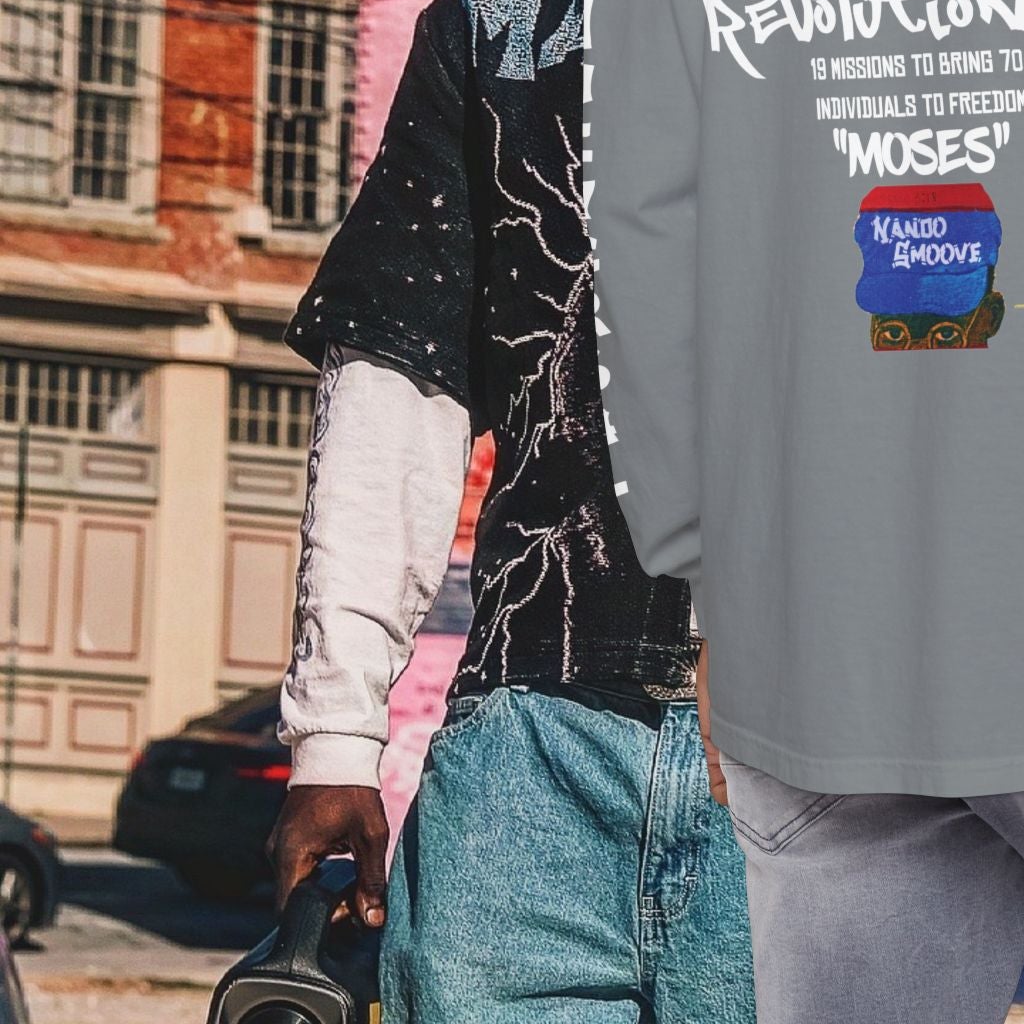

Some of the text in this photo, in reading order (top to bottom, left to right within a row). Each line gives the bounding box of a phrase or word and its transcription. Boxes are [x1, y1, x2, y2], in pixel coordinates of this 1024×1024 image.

[810, 48, 1024, 81] 19 MISSIONS TO BRING 70
[815, 94, 917, 122] INDIVIDUALS
[921, 92, 945, 117] TO
[832, 121, 1011, 178] "MOSES"
[870, 215, 947, 244] NANDO
[892, 239, 982, 270] SMOOVE
